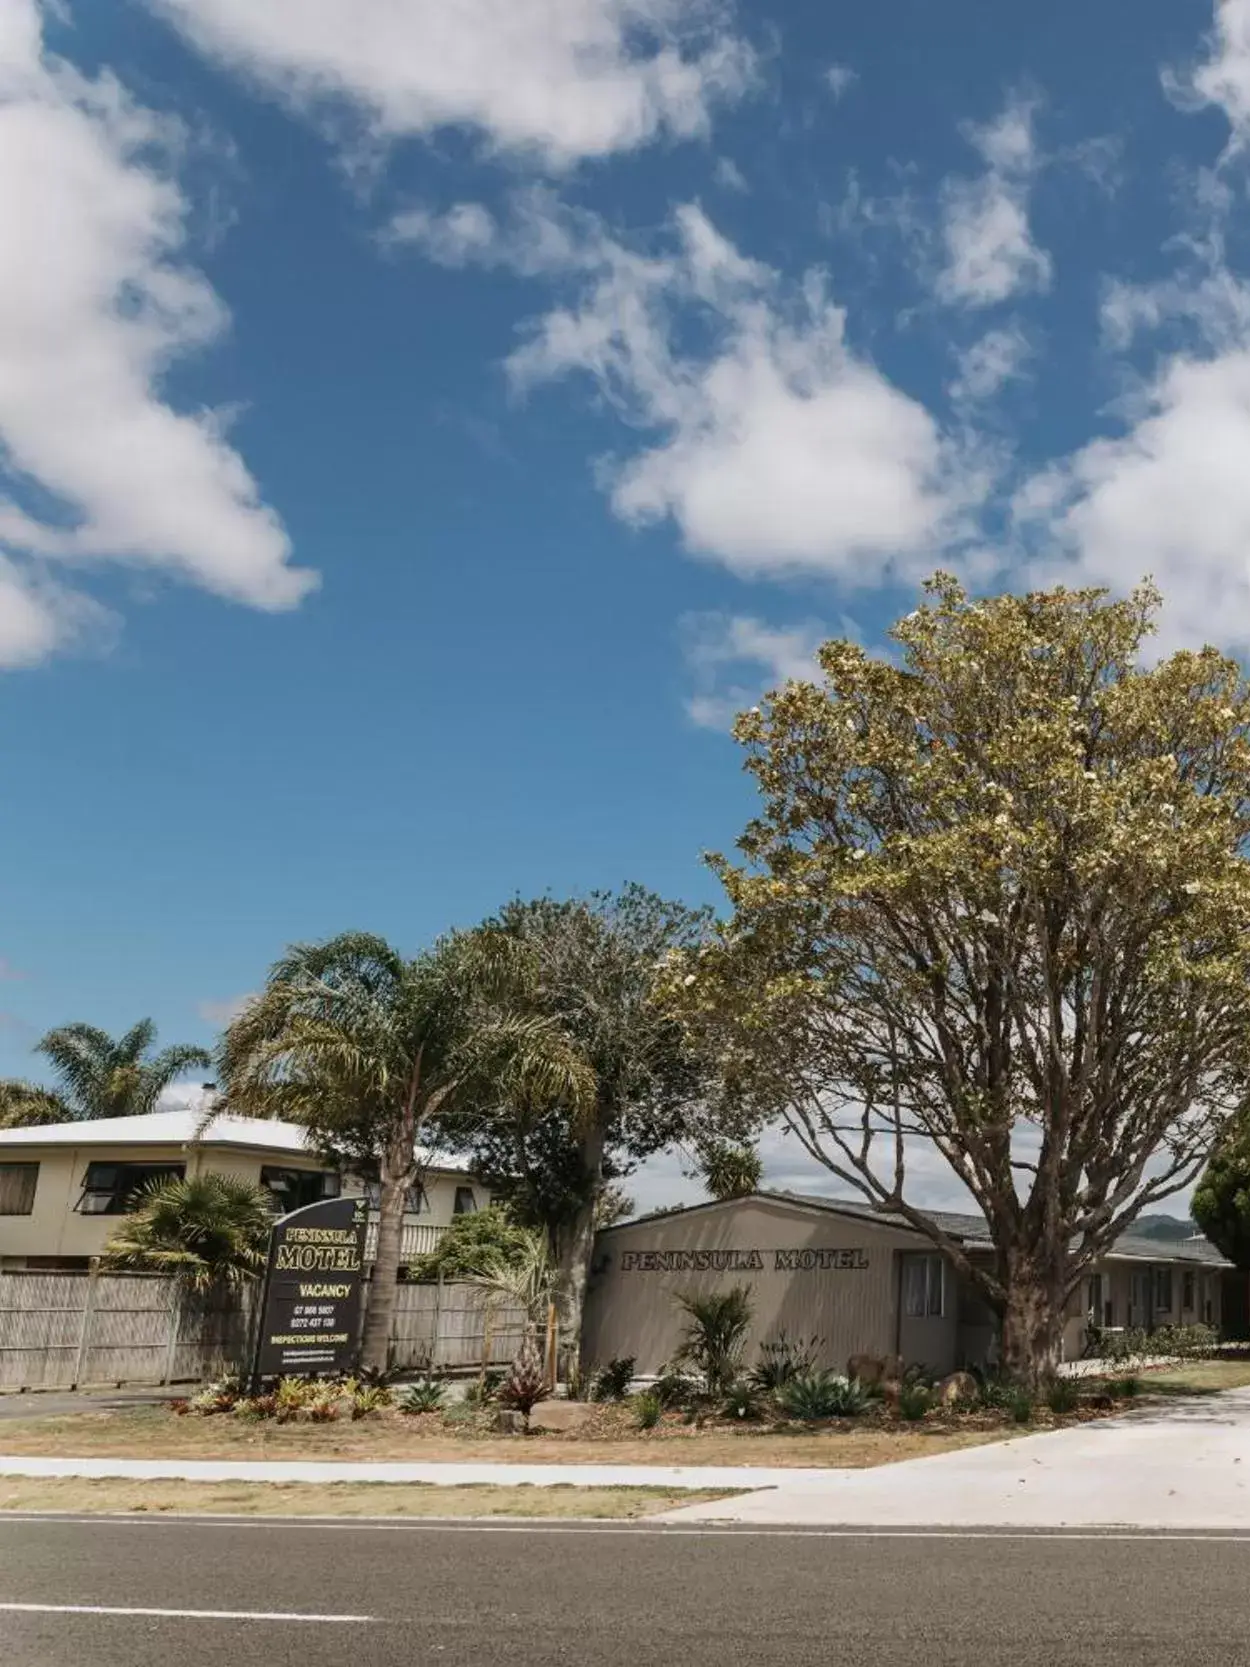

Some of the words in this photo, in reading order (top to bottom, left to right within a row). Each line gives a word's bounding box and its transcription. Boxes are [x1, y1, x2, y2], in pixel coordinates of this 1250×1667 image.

[286, 1227, 357, 1244] PENINSULA
[275, 1245, 360, 1271] MOTEL
[621, 1251, 764, 1271] PENINSULA
[774, 1248, 870, 1270] MOTEL
[300, 1284, 352, 1298] VACANCY
[316, 1333, 348, 1343] WELCOME
